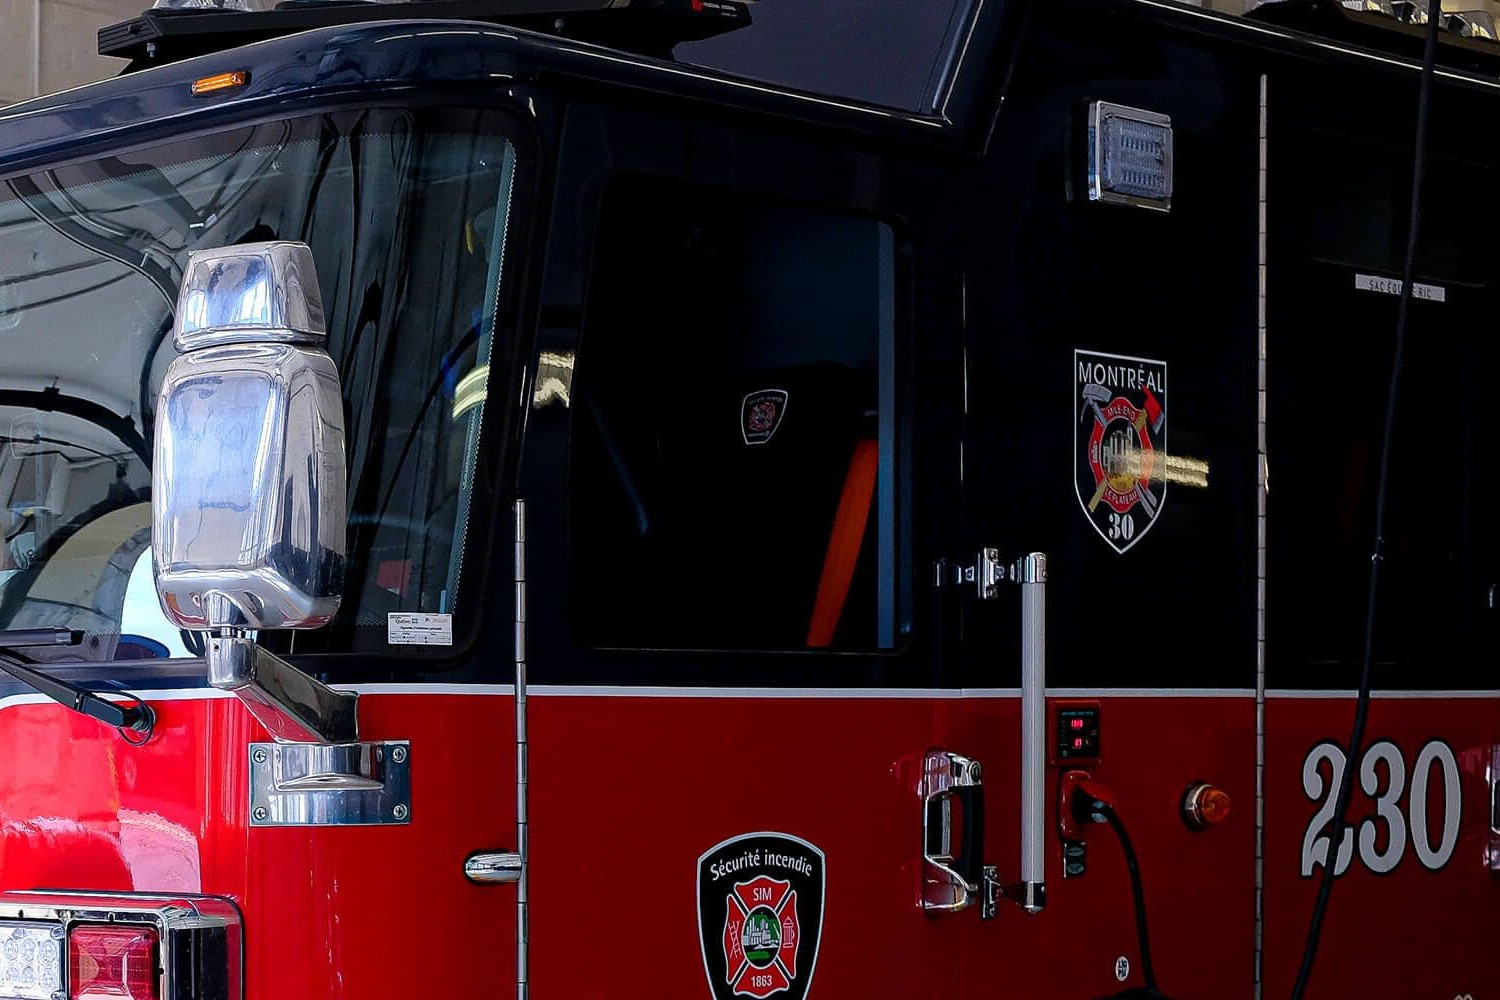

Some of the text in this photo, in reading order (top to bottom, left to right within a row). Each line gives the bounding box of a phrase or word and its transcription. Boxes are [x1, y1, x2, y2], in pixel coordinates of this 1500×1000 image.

[1078, 360, 1164, 393] MONTRÉAL
[1108, 512, 1135, 540] 30
[1300, 739, 1463, 877] 230
[710, 848, 813, 881] Sécurité incendie
[753, 887, 772, 901] SIM
[751, 975, 773, 988] 1863
